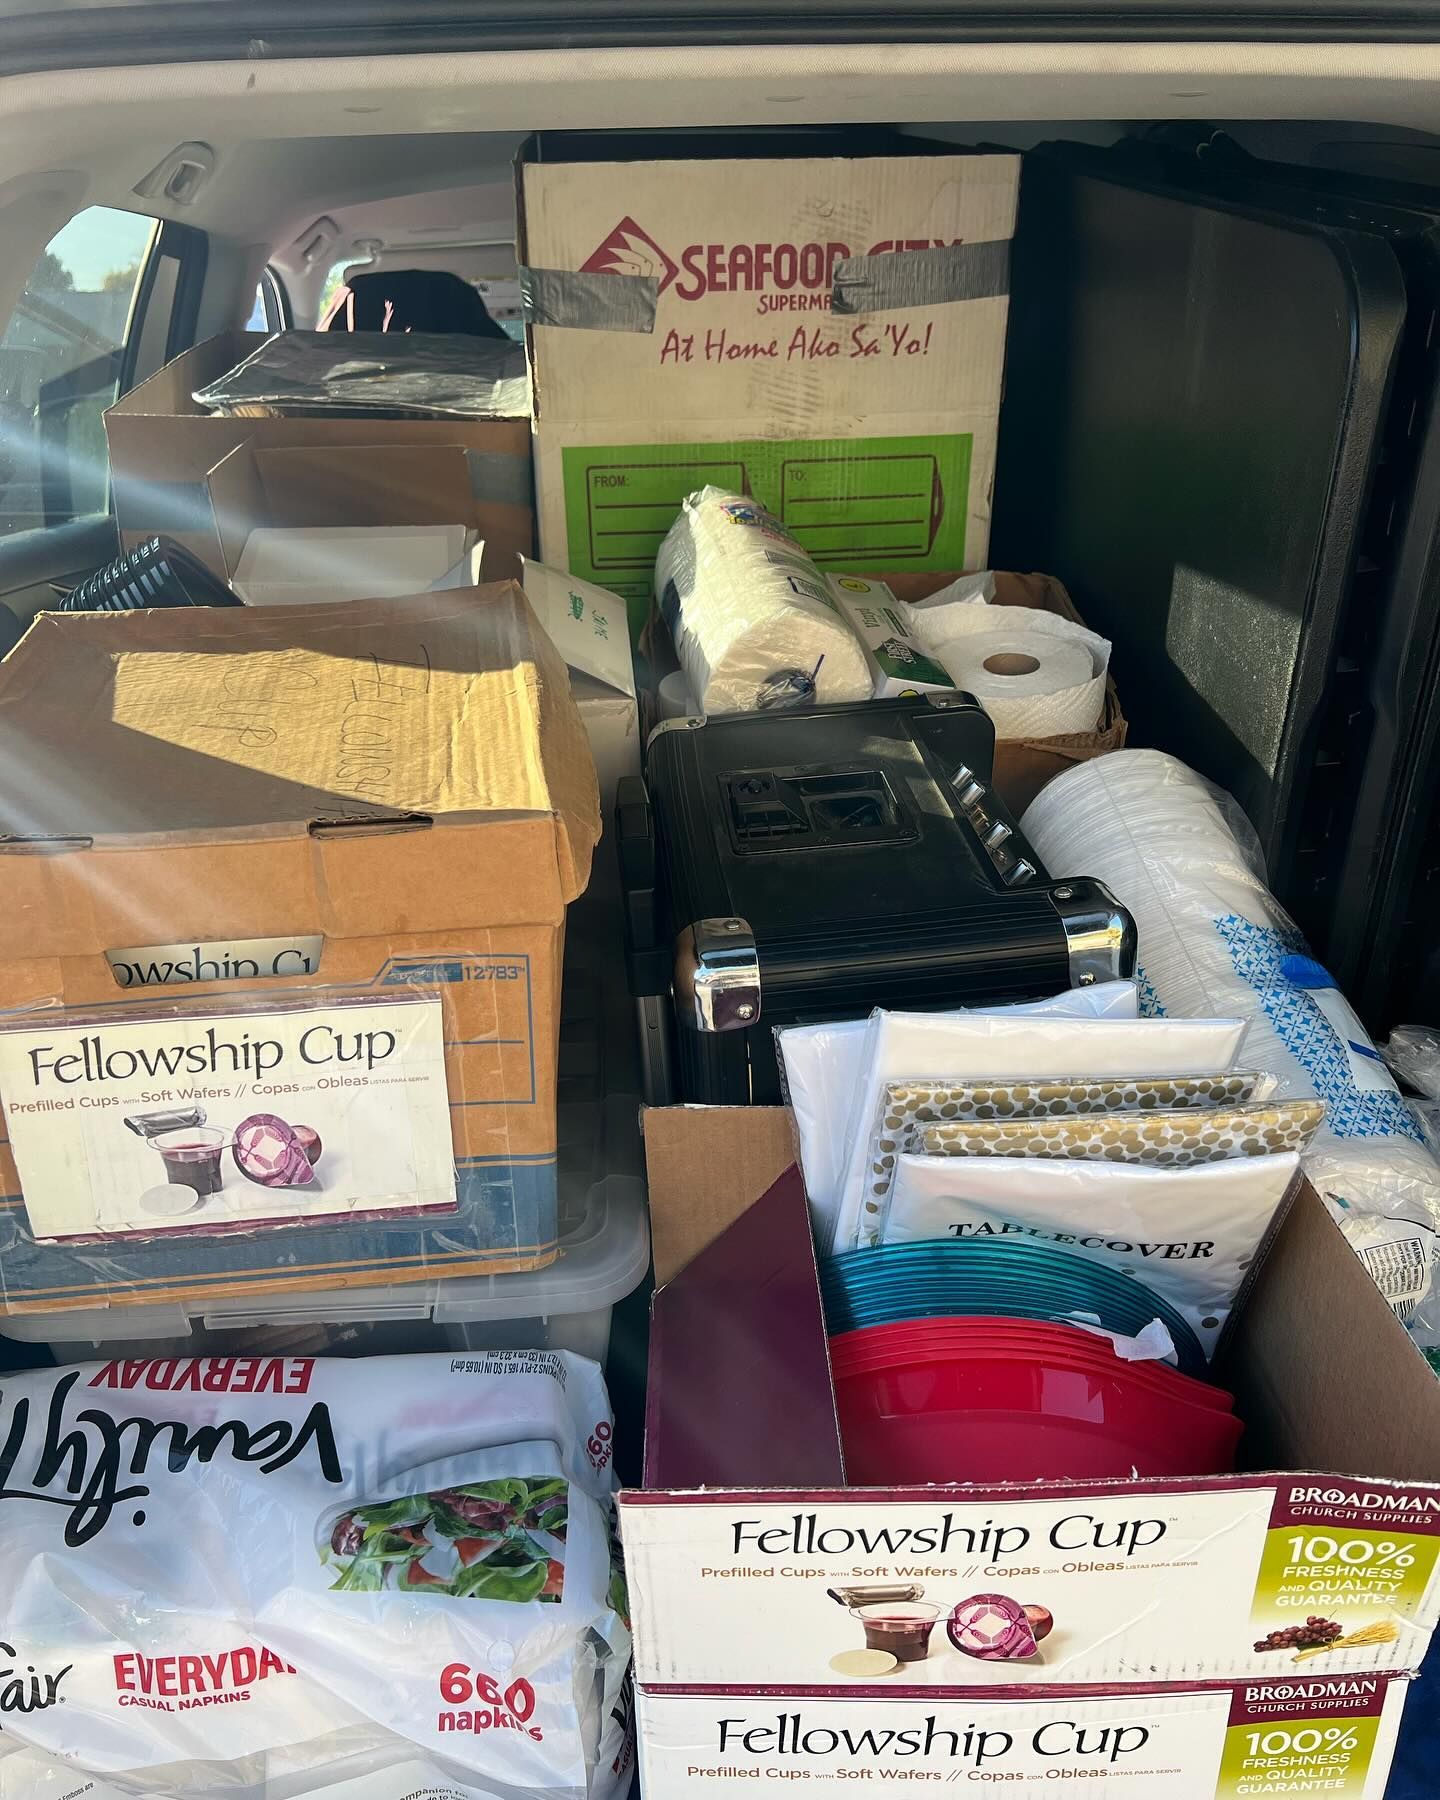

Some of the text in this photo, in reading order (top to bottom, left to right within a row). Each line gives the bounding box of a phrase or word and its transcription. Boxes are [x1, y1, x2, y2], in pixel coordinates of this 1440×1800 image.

[660, 328, 694, 365] At
[705, 328, 779, 364] Home
[787, 325, 840, 362] Ako
[594, 475, 629, 488] FROM:
[27, 1027, 283, 1086] Fellowship
[9, 1098, 75, 1114] Prefilled
[79, 1095, 120, 1109] Cups
[140, 1088, 173, 1103] Soft
[176, 1086, 231, 1100] Wafers
[251, 1082, 300, 1096] Copas
[317, 1075, 369, 1089] Obleas
[949, 1221, 1215, 1259] TABLECOVER
[87, 1358, 316, 1394] EVERYDAY
[32, 1371, 343, 1548] Vanity
[1288, 1487, 1440, 1512] BROADMAN
[1290, 1506, 1433, 1524] CHURCH SUPPLIES
[731, 1513, 1030, 1562] Fellowship
[1287, 1535, 1417, 1567] 100%
[700, 1566, 775, 1578] Prefilled
[780, 1566, 826, 1580] Cups
[851, 1566, 889, 1577] Soft
[894, 1566, 958, 1577] Wafers
[983, 1565, 1041, 1578] Copas
[1062, 1561, 1125, 1574] Obleas
[1282, 1565, 1407, 1580] FRESHNESS
[1308, 1579, 1403, 1593] QUALITY
[1275, 1592, 1398, 1607] GUARANTEE
[118, 1690, 251, 1712] CASUAL NAPKINS
[440, 1662, 536, 1722] 660
[1245, 1680, 1377, 1702] BROADMAN
[1247, 1698, 1369, 1714] CHURCH SUPPLIES
[716, 1713, 1013, 1767] Fellowship
[1245, 1726, 1359, 1756] 100%
[1242, 1752, 1351, 1769] FRESHNESS
[687, 1766, 760, 1778] Prefilled
[766, 1767, 811, 1780] Cups
[836, 1768, 873, 1779] Soft
[879, 1768, 942, 1780] Wafers
[967, 1770, 1024, 1783] Copas
[1045, 1767, 1108, 1780] Obleas
[1266, 1766, 1350, 1781] QUALITY
[1236, 1778, 1347, 1795] GUARANTEE
